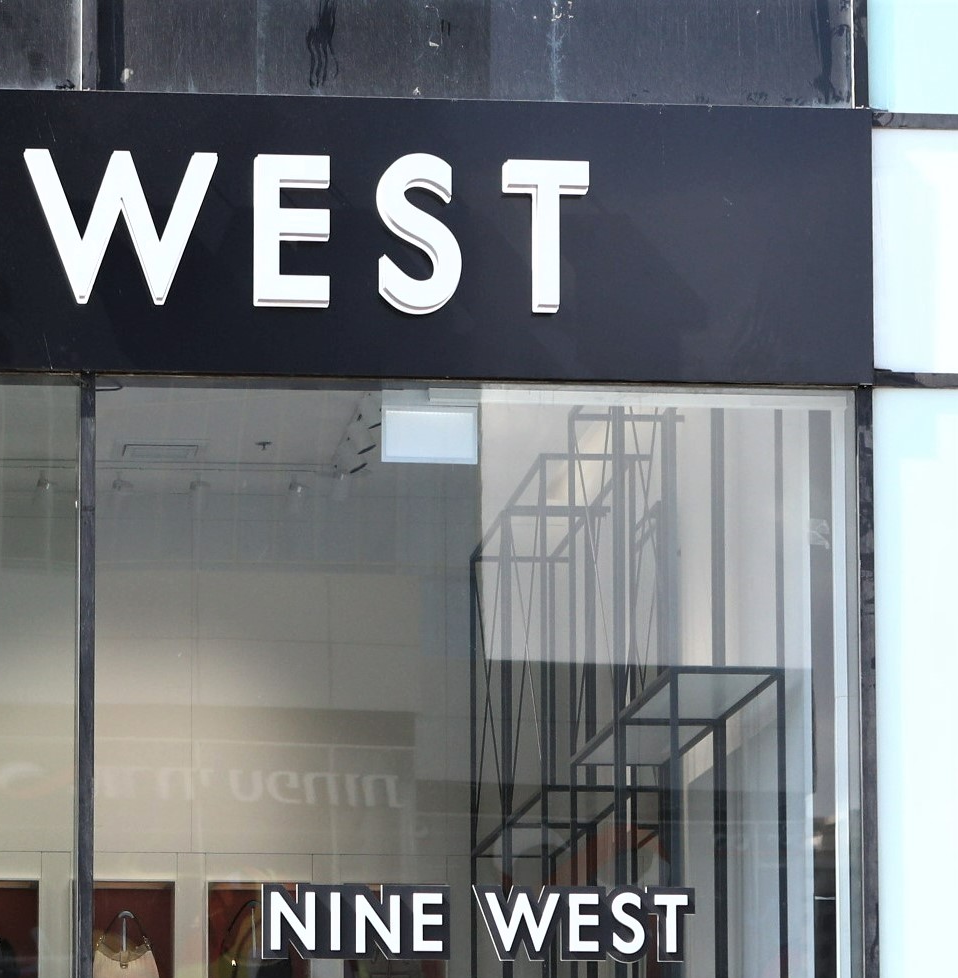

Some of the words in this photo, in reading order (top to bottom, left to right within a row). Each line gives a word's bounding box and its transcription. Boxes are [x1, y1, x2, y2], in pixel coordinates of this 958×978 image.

[23, 148, 590, 315] WEST
[268, 889, 445, 955] NINE
[484, 890, 690, 956] WEST
